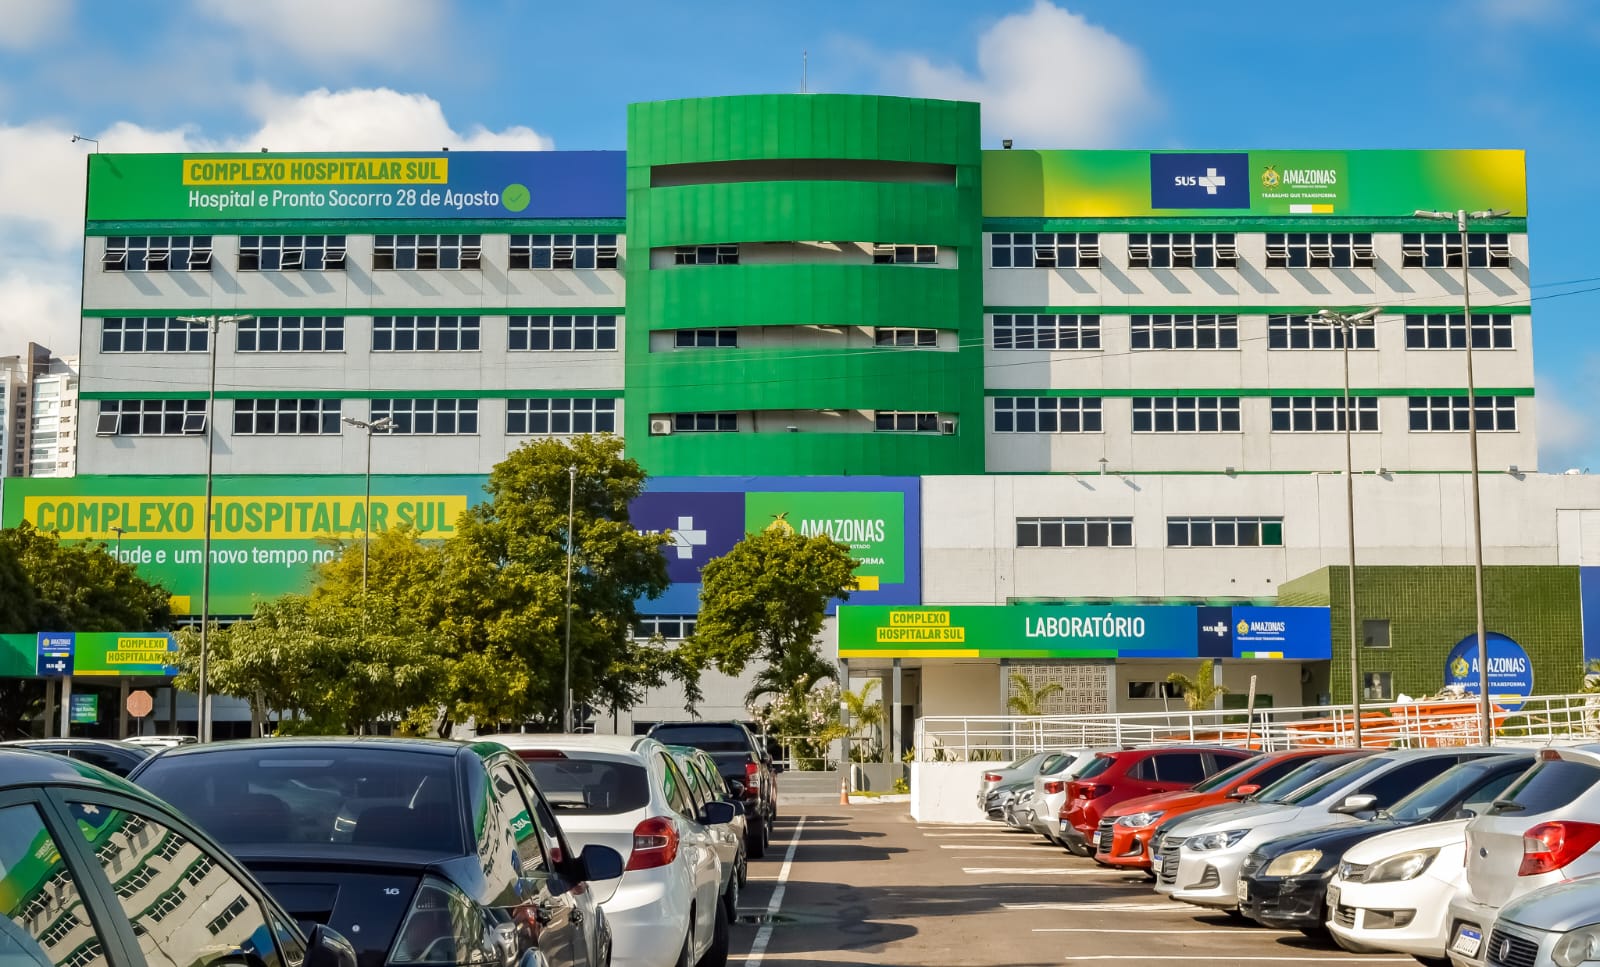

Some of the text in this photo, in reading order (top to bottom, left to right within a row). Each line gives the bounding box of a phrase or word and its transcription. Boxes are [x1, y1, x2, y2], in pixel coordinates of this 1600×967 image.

[190, 161, 441, 181] COMPLEXO HOSPITALAR SUL
[1282, 169, 1337, 185] AMAZONAS
[1174, 176, 1196, 186] SUS
[188, 189, 499, 212] Hospital e Pronto Socorro 28 de Agosto
[37, 502, 454, 532] COMPLEXO HOSPITALAR SUL
[800, 519, 885, 543] AMAZONAS
[155, 549, 166, 564] e
[174, 549, 203, 564] um
[208, 549, 248, 564] novo
[252, 546, 308, 569] tempo
[892, 613, 946, 624] COMPLEXO
[1025, 612, 1146, 638] LABORATÓRIO
[1250, 621, 1285, 631] AMAZONAS
[879, 628, 963, 640] HOSPITALAR SUL
[120, 640, 165, 649] COMPLEXO
[1472, 657, 1526, 673] AAZONAS
